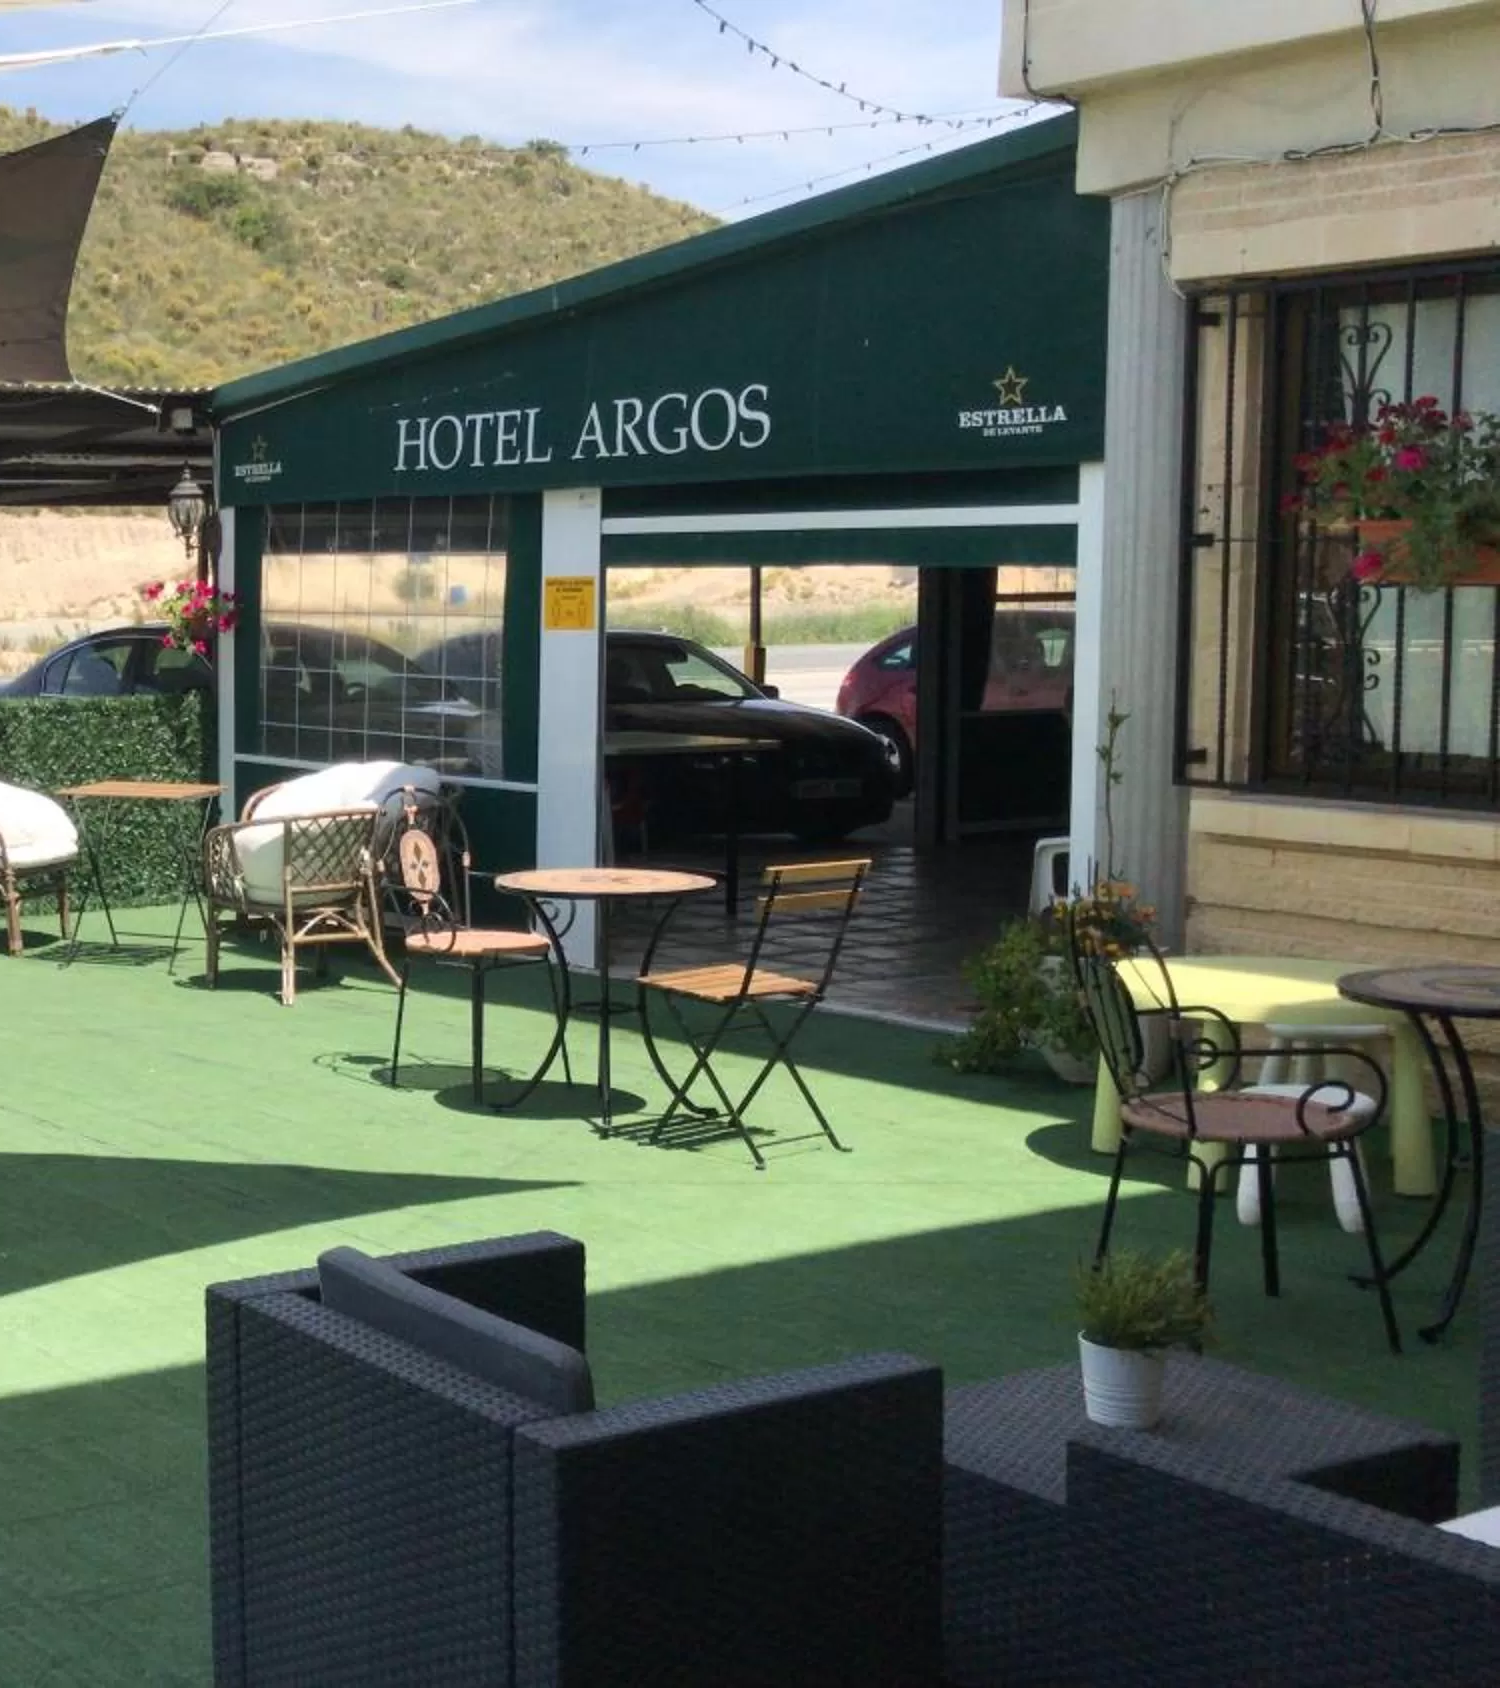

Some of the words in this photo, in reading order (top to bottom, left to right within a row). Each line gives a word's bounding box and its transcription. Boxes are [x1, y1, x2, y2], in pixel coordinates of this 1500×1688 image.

[958, 404, 1068, 428] ESTRELLA
[394, 407, 553, 471] HOTEL
[571, 384, 771, 460] ARGOS
[983, 427, 996, 437] DE
[998, 424, 1043, 436] LEVANTE
[234, 461, 282, 477] ESTRELLA
